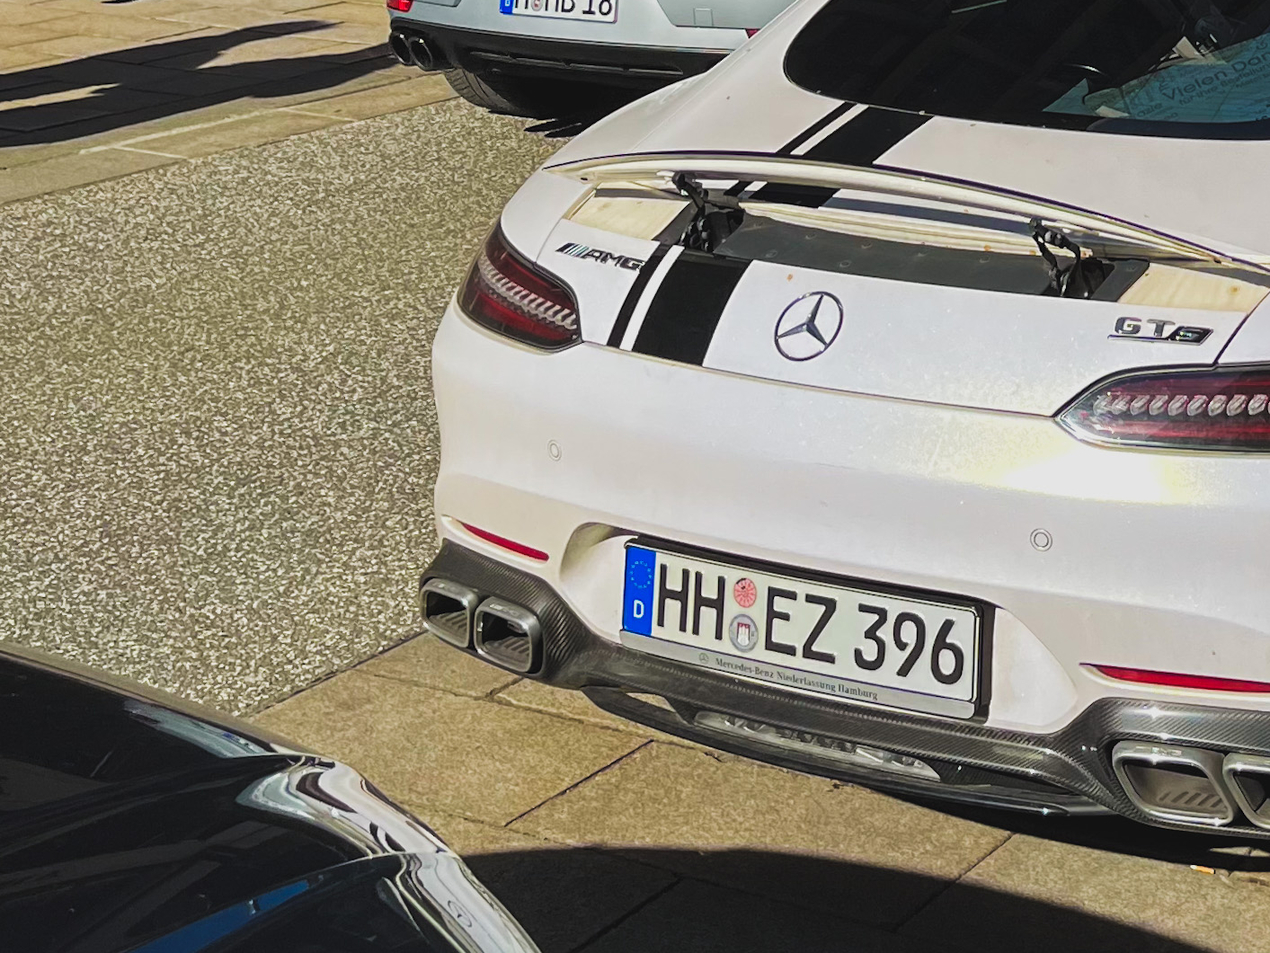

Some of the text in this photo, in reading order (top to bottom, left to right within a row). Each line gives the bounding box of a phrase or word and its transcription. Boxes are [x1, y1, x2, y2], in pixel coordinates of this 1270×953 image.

[580, 248, 645, 272] AMG
[633, 563, 965, 686] D HH EZ 396
[714, 656, 879, 701] Mercedes-Benz Niederlassung Hamburg
